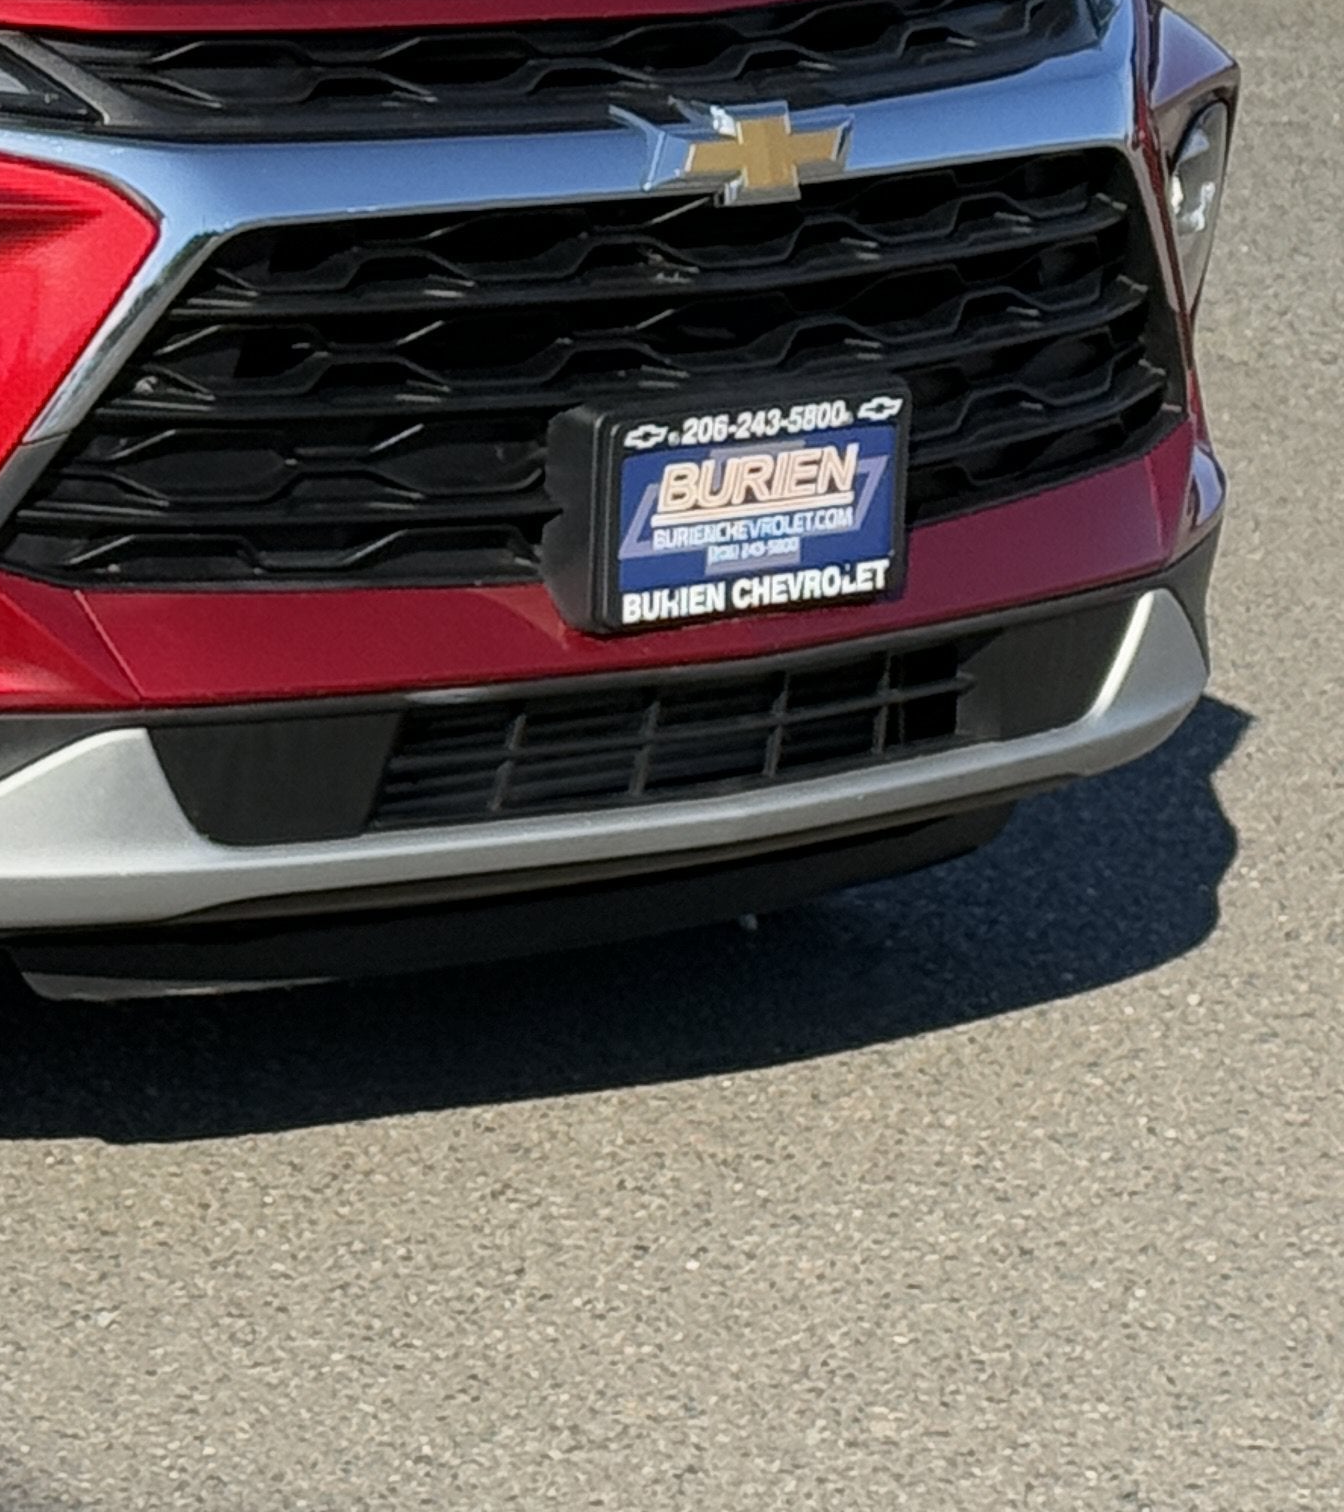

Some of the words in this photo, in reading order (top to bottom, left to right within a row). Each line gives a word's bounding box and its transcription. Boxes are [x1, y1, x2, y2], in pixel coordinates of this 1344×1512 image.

[679, 399, 847, 446] 206-243-5800
[657, 442, 860, 513] BURIEN
[652, 506, 854, 551] BURIENCHEVROLET.COM
